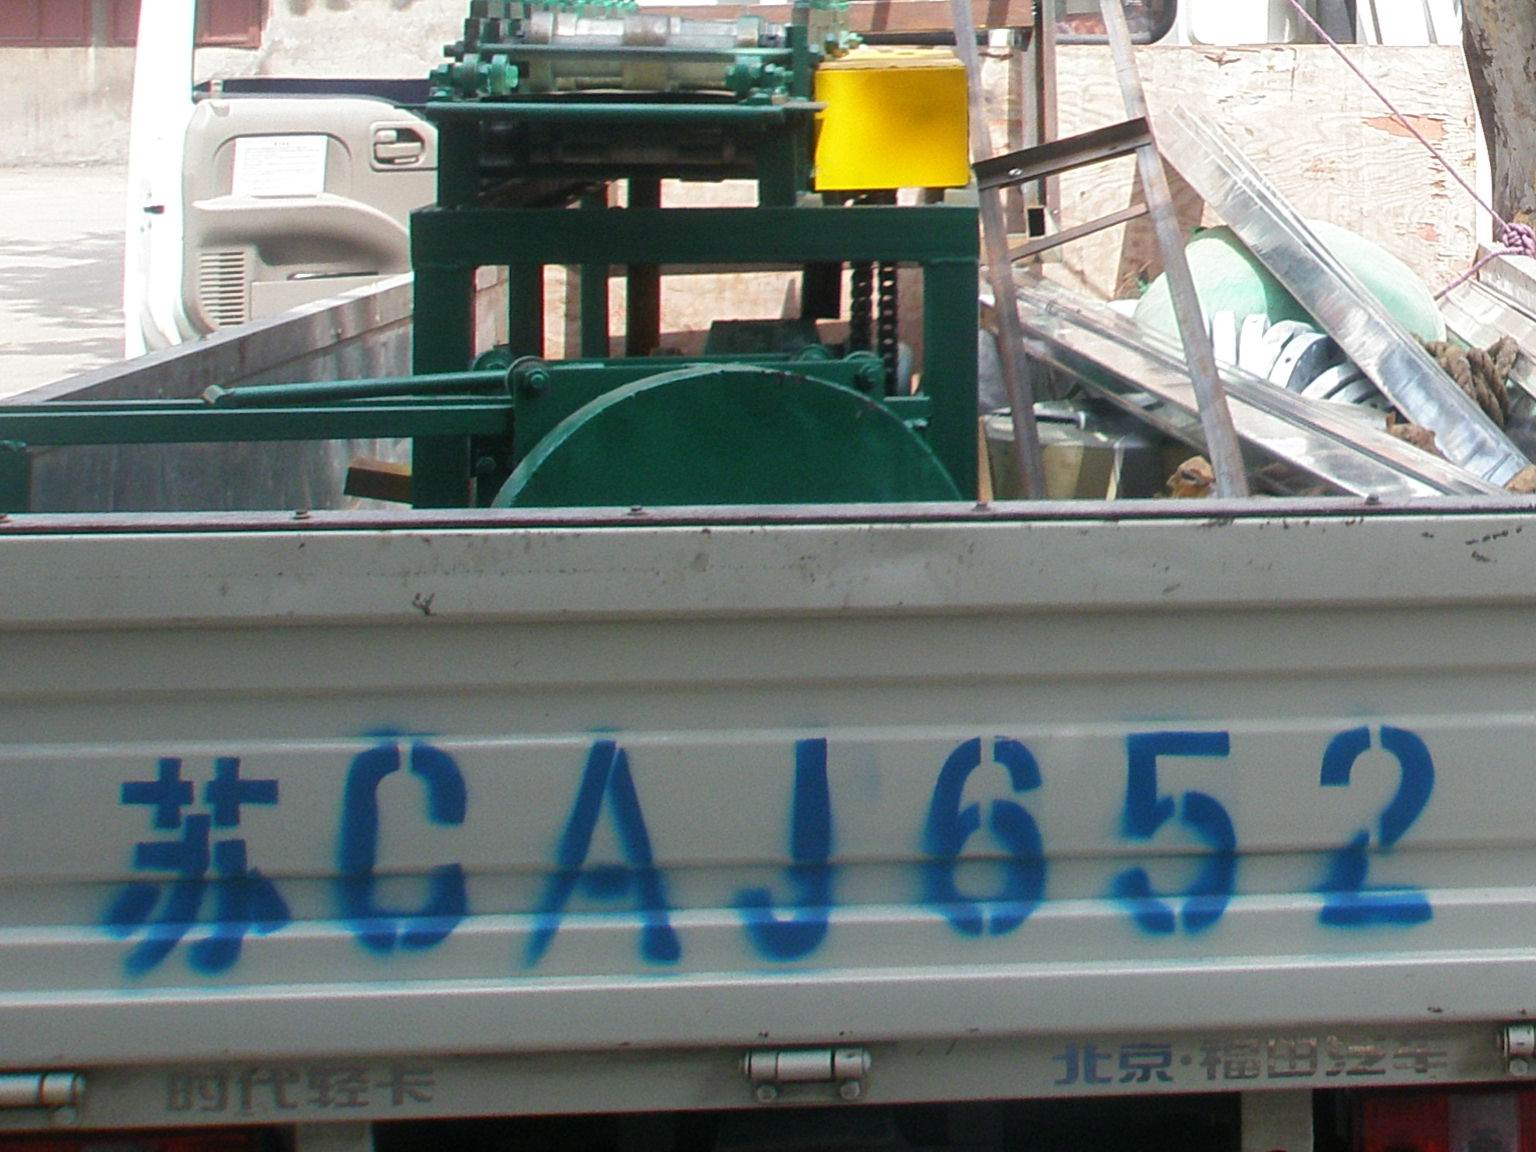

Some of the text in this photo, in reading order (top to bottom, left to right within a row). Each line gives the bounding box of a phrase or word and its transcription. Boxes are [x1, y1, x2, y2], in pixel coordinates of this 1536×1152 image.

[102, 726, 1436, 976] 苏CAJ652
[164, 1057, 436, 1116] 时代轻卡
